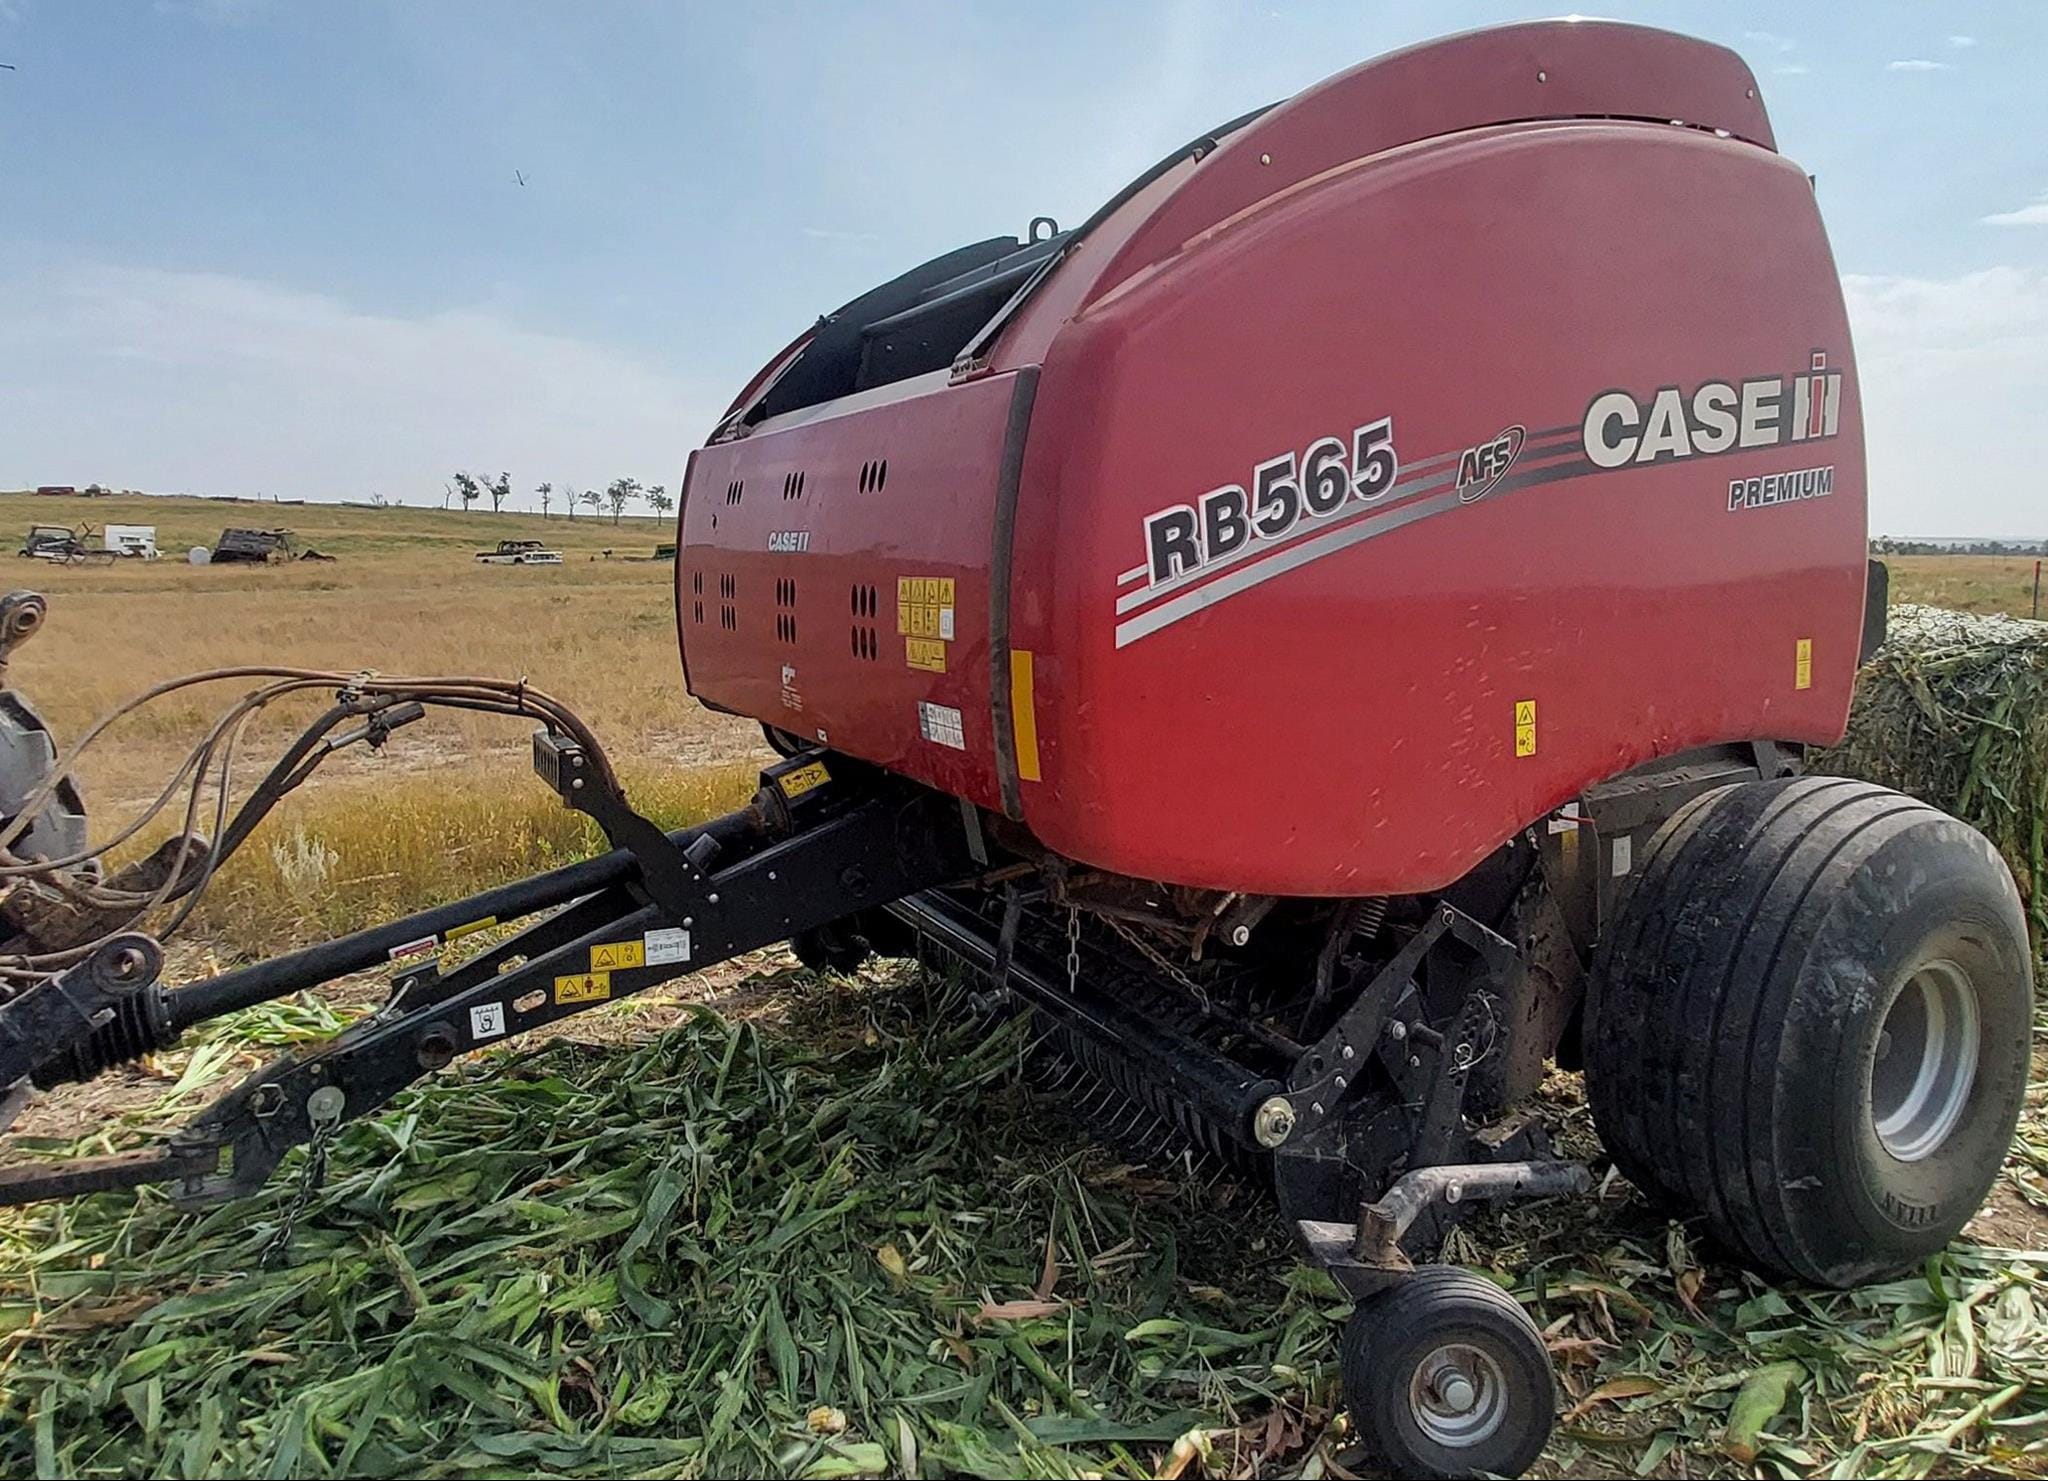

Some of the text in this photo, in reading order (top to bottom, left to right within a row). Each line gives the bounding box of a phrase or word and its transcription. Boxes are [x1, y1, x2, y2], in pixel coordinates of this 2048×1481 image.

[1583, 377, 1783, 468] CASE
[1455, 436, 1512, 489] AFS
[1727, 465, 1834, 511] PREMIUM
[1143, 415, 1398, 590] RB565
[768, 531, 798, 552] CASE
